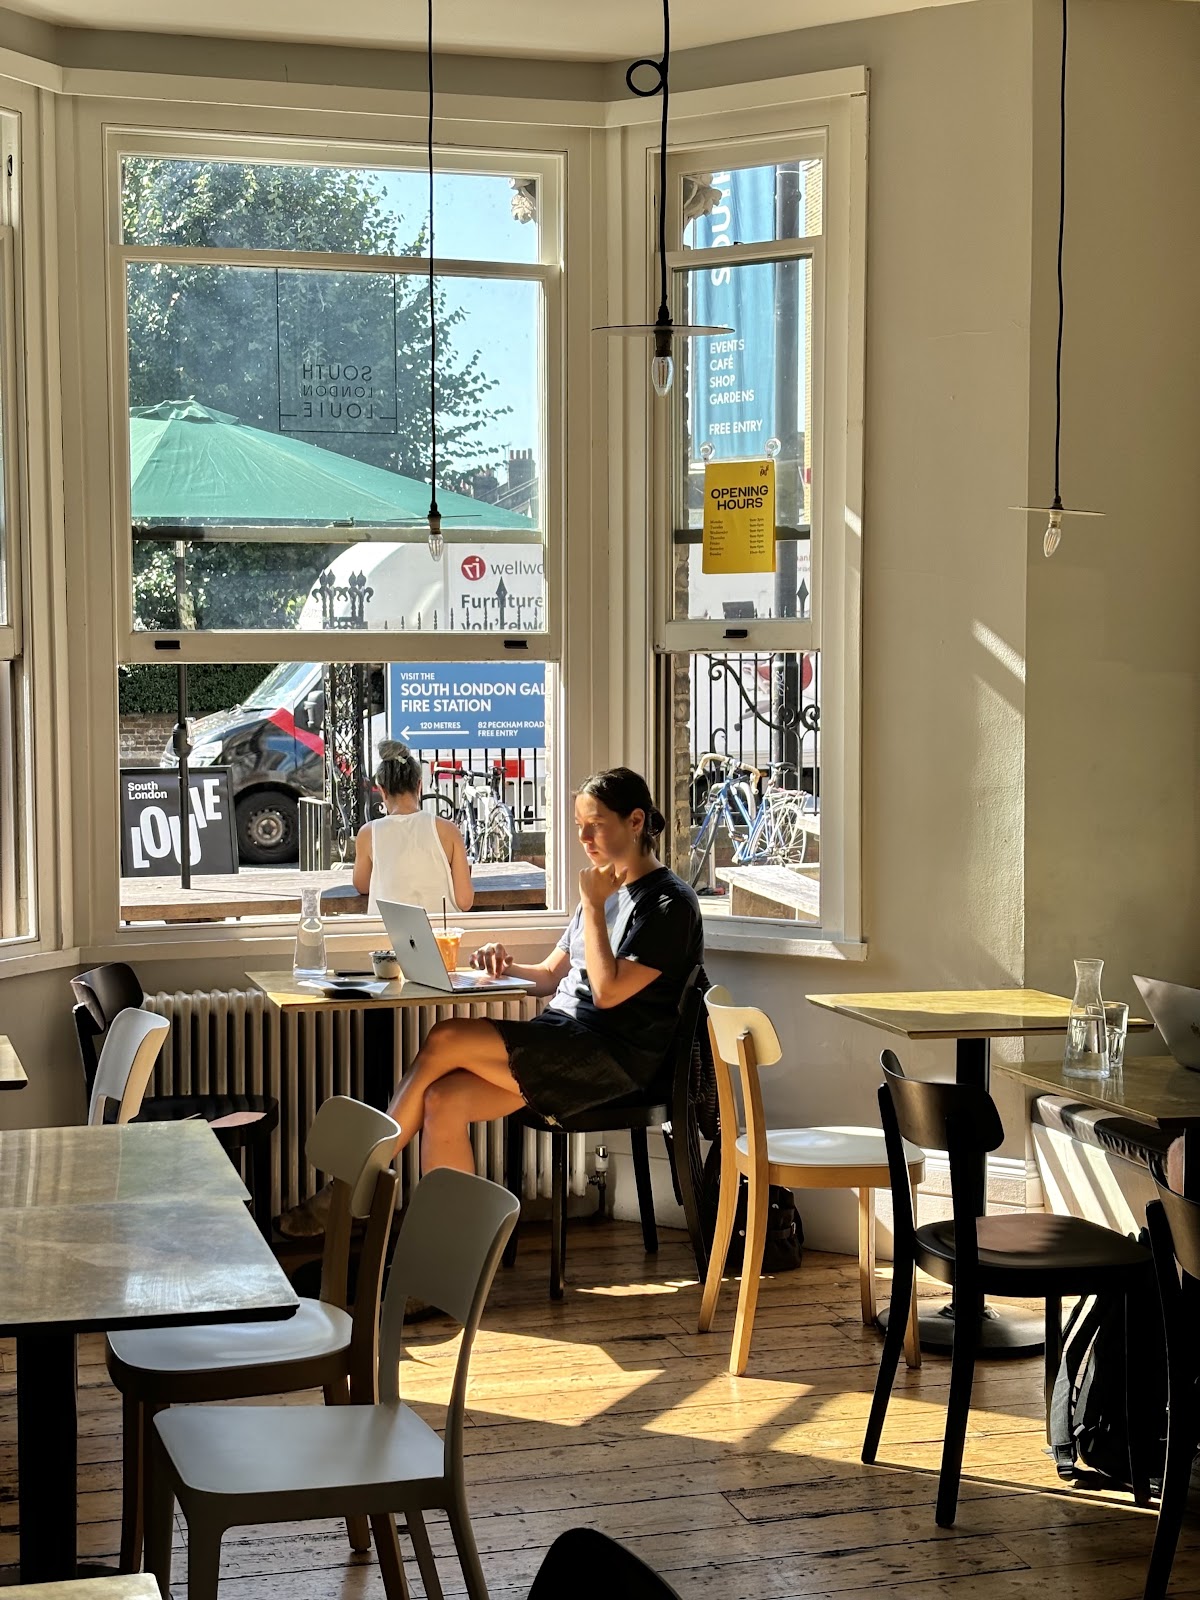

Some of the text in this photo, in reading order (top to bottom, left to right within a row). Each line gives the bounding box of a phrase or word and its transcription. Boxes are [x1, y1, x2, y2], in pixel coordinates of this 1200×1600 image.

[710, 339, 744, 354] EVENTS
[709, 355, 734, 371] CAFÉ
[709, 375, 736, 388] SHOP
[709, 390, 755, 405] GARDENS
[709, 420, 763, 435] FREE ENTRY
[710, 485, 769, 499] OPENING
[717, 497, 763, 510] HOURS
[461, 594, 544, 609] Furnture
[400, 672, 435, 681] VISIT THE
[401, 683, 450, 696] SOUTH
[453, 682, 516, 696] LONDON
[401, 699, 492, 712] FIRE STATION
[478, 720, 545, 729] 82 PECKHAM ROAD
[128, 781, 158, 791] South
[128, 790, 168, 800] London
[130, 778, 222, 869] LOUIE
